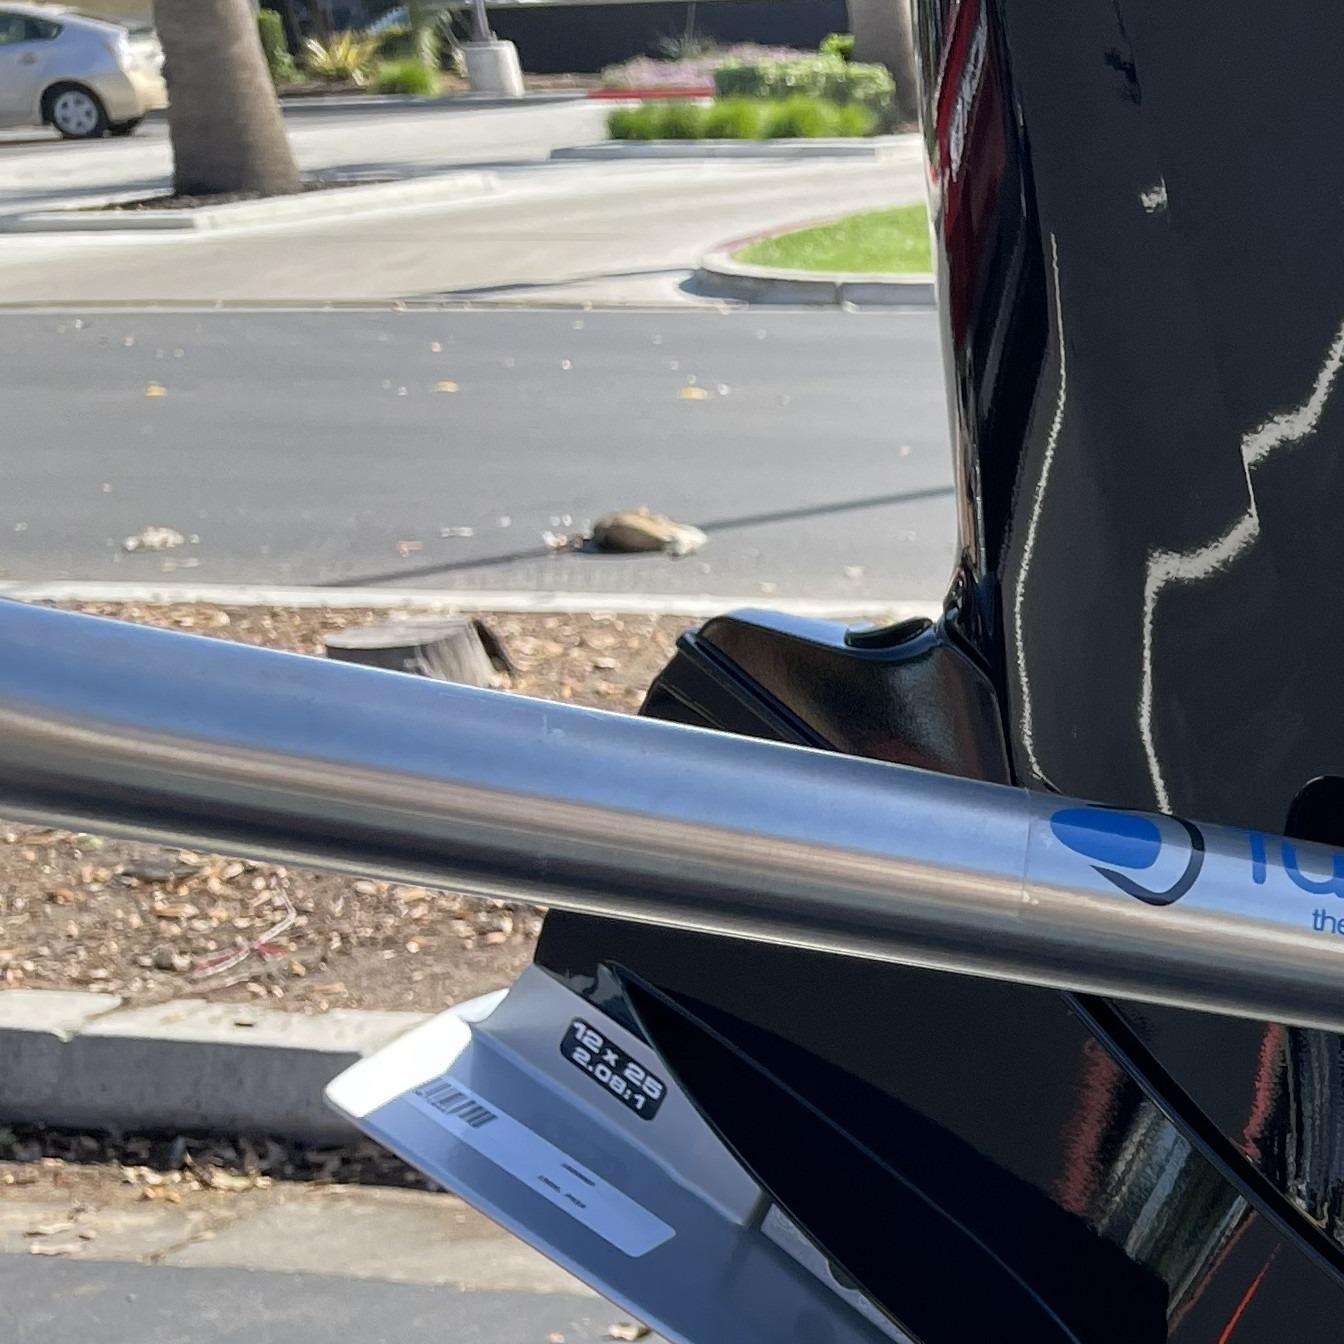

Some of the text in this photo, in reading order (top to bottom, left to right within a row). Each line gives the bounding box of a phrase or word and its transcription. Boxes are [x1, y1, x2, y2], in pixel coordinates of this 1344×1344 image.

[571, 1046, 646, 1111] 2.08:1
[573, 1021, 664, 1101] 12 x 25
